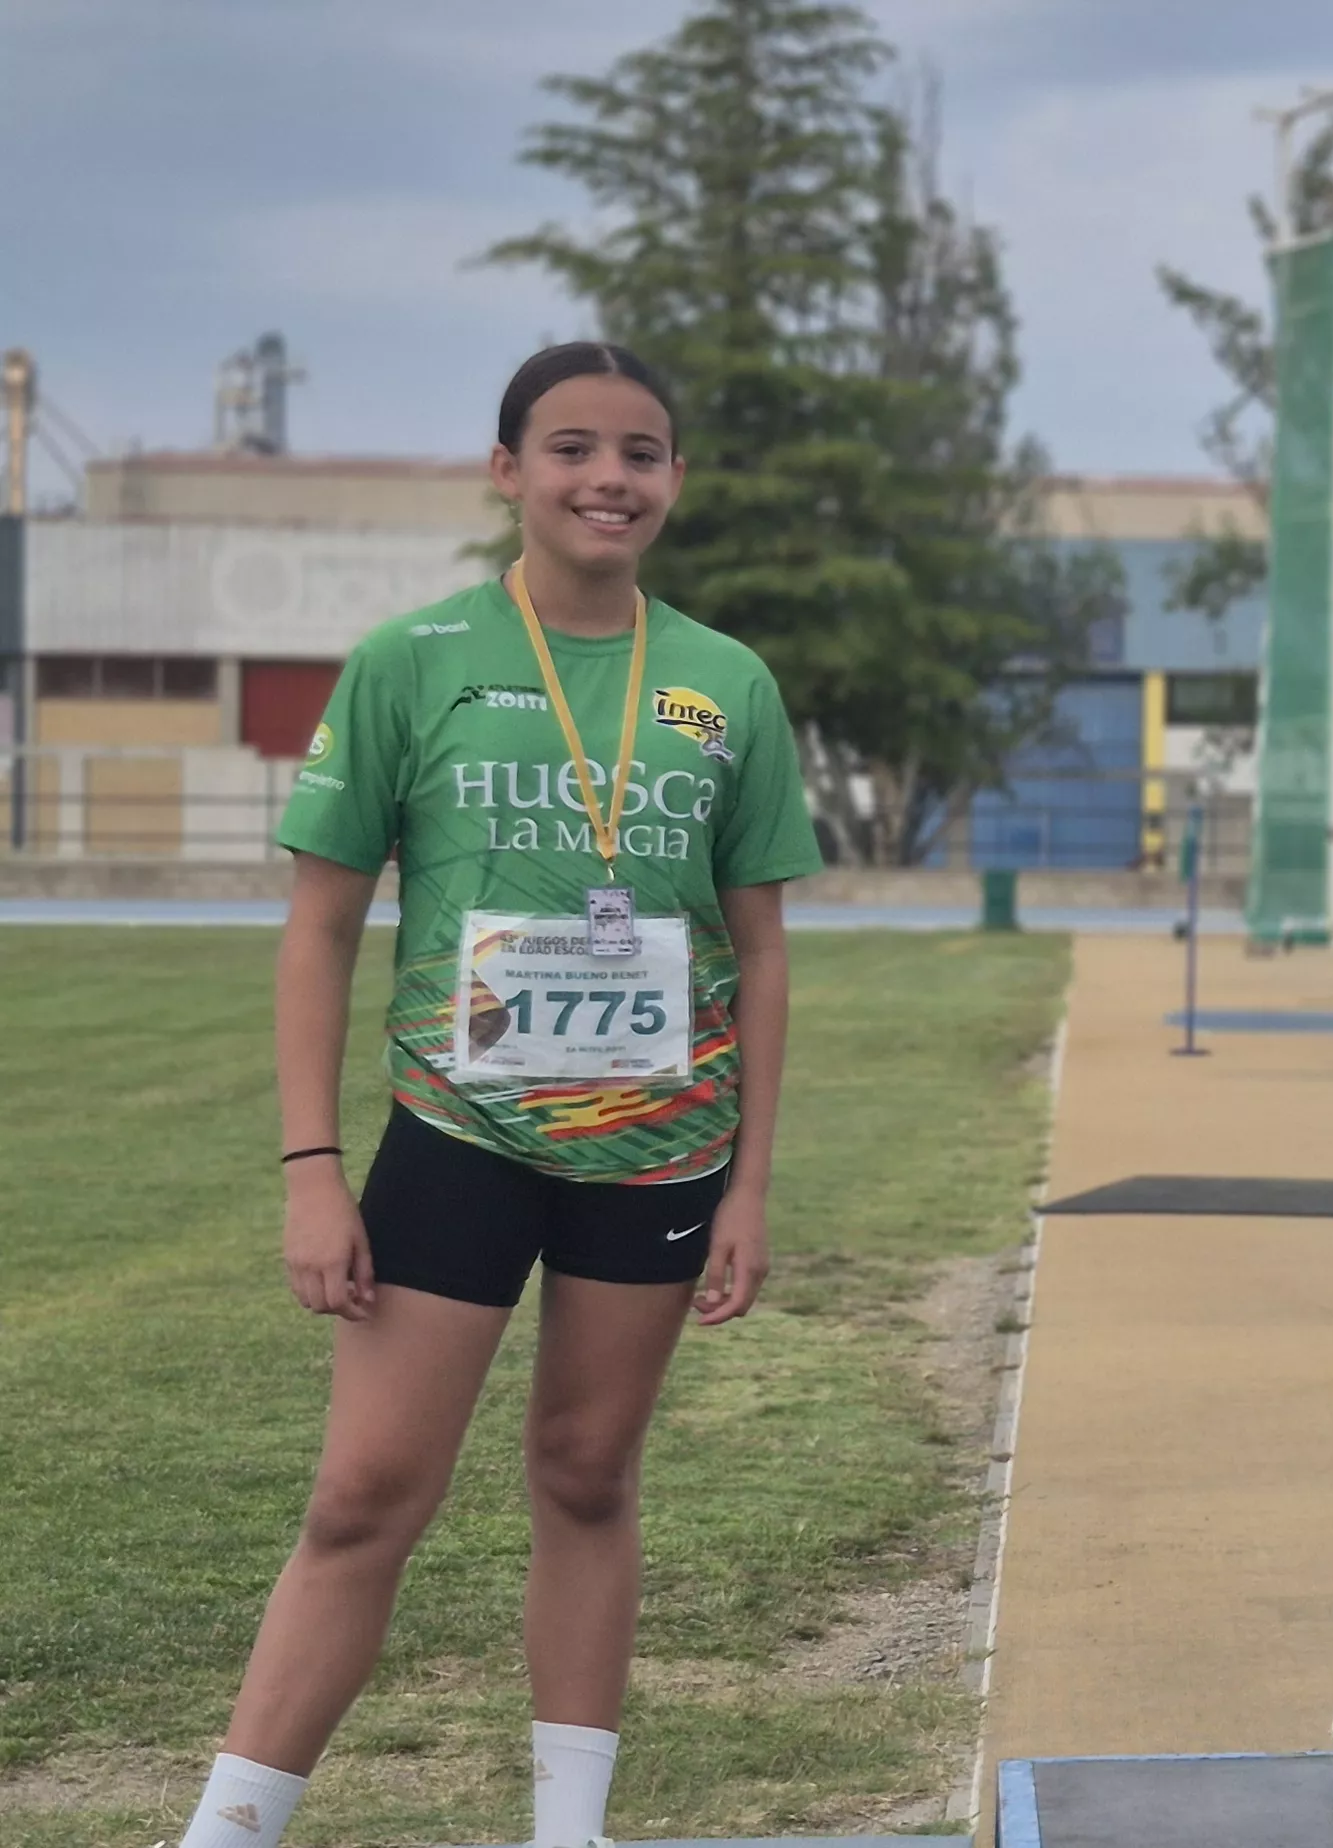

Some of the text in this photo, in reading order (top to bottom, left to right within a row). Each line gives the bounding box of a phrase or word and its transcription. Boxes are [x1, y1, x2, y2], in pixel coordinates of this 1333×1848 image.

[452, 758, 716, 825] Huesca
[487, 817, 540, 850] La
[522, 936, 568, 946] JUEGOS
[504, 969, 650, 980] MARTINA BUENO BENET
[505, 989, 667, 1036] 1775
